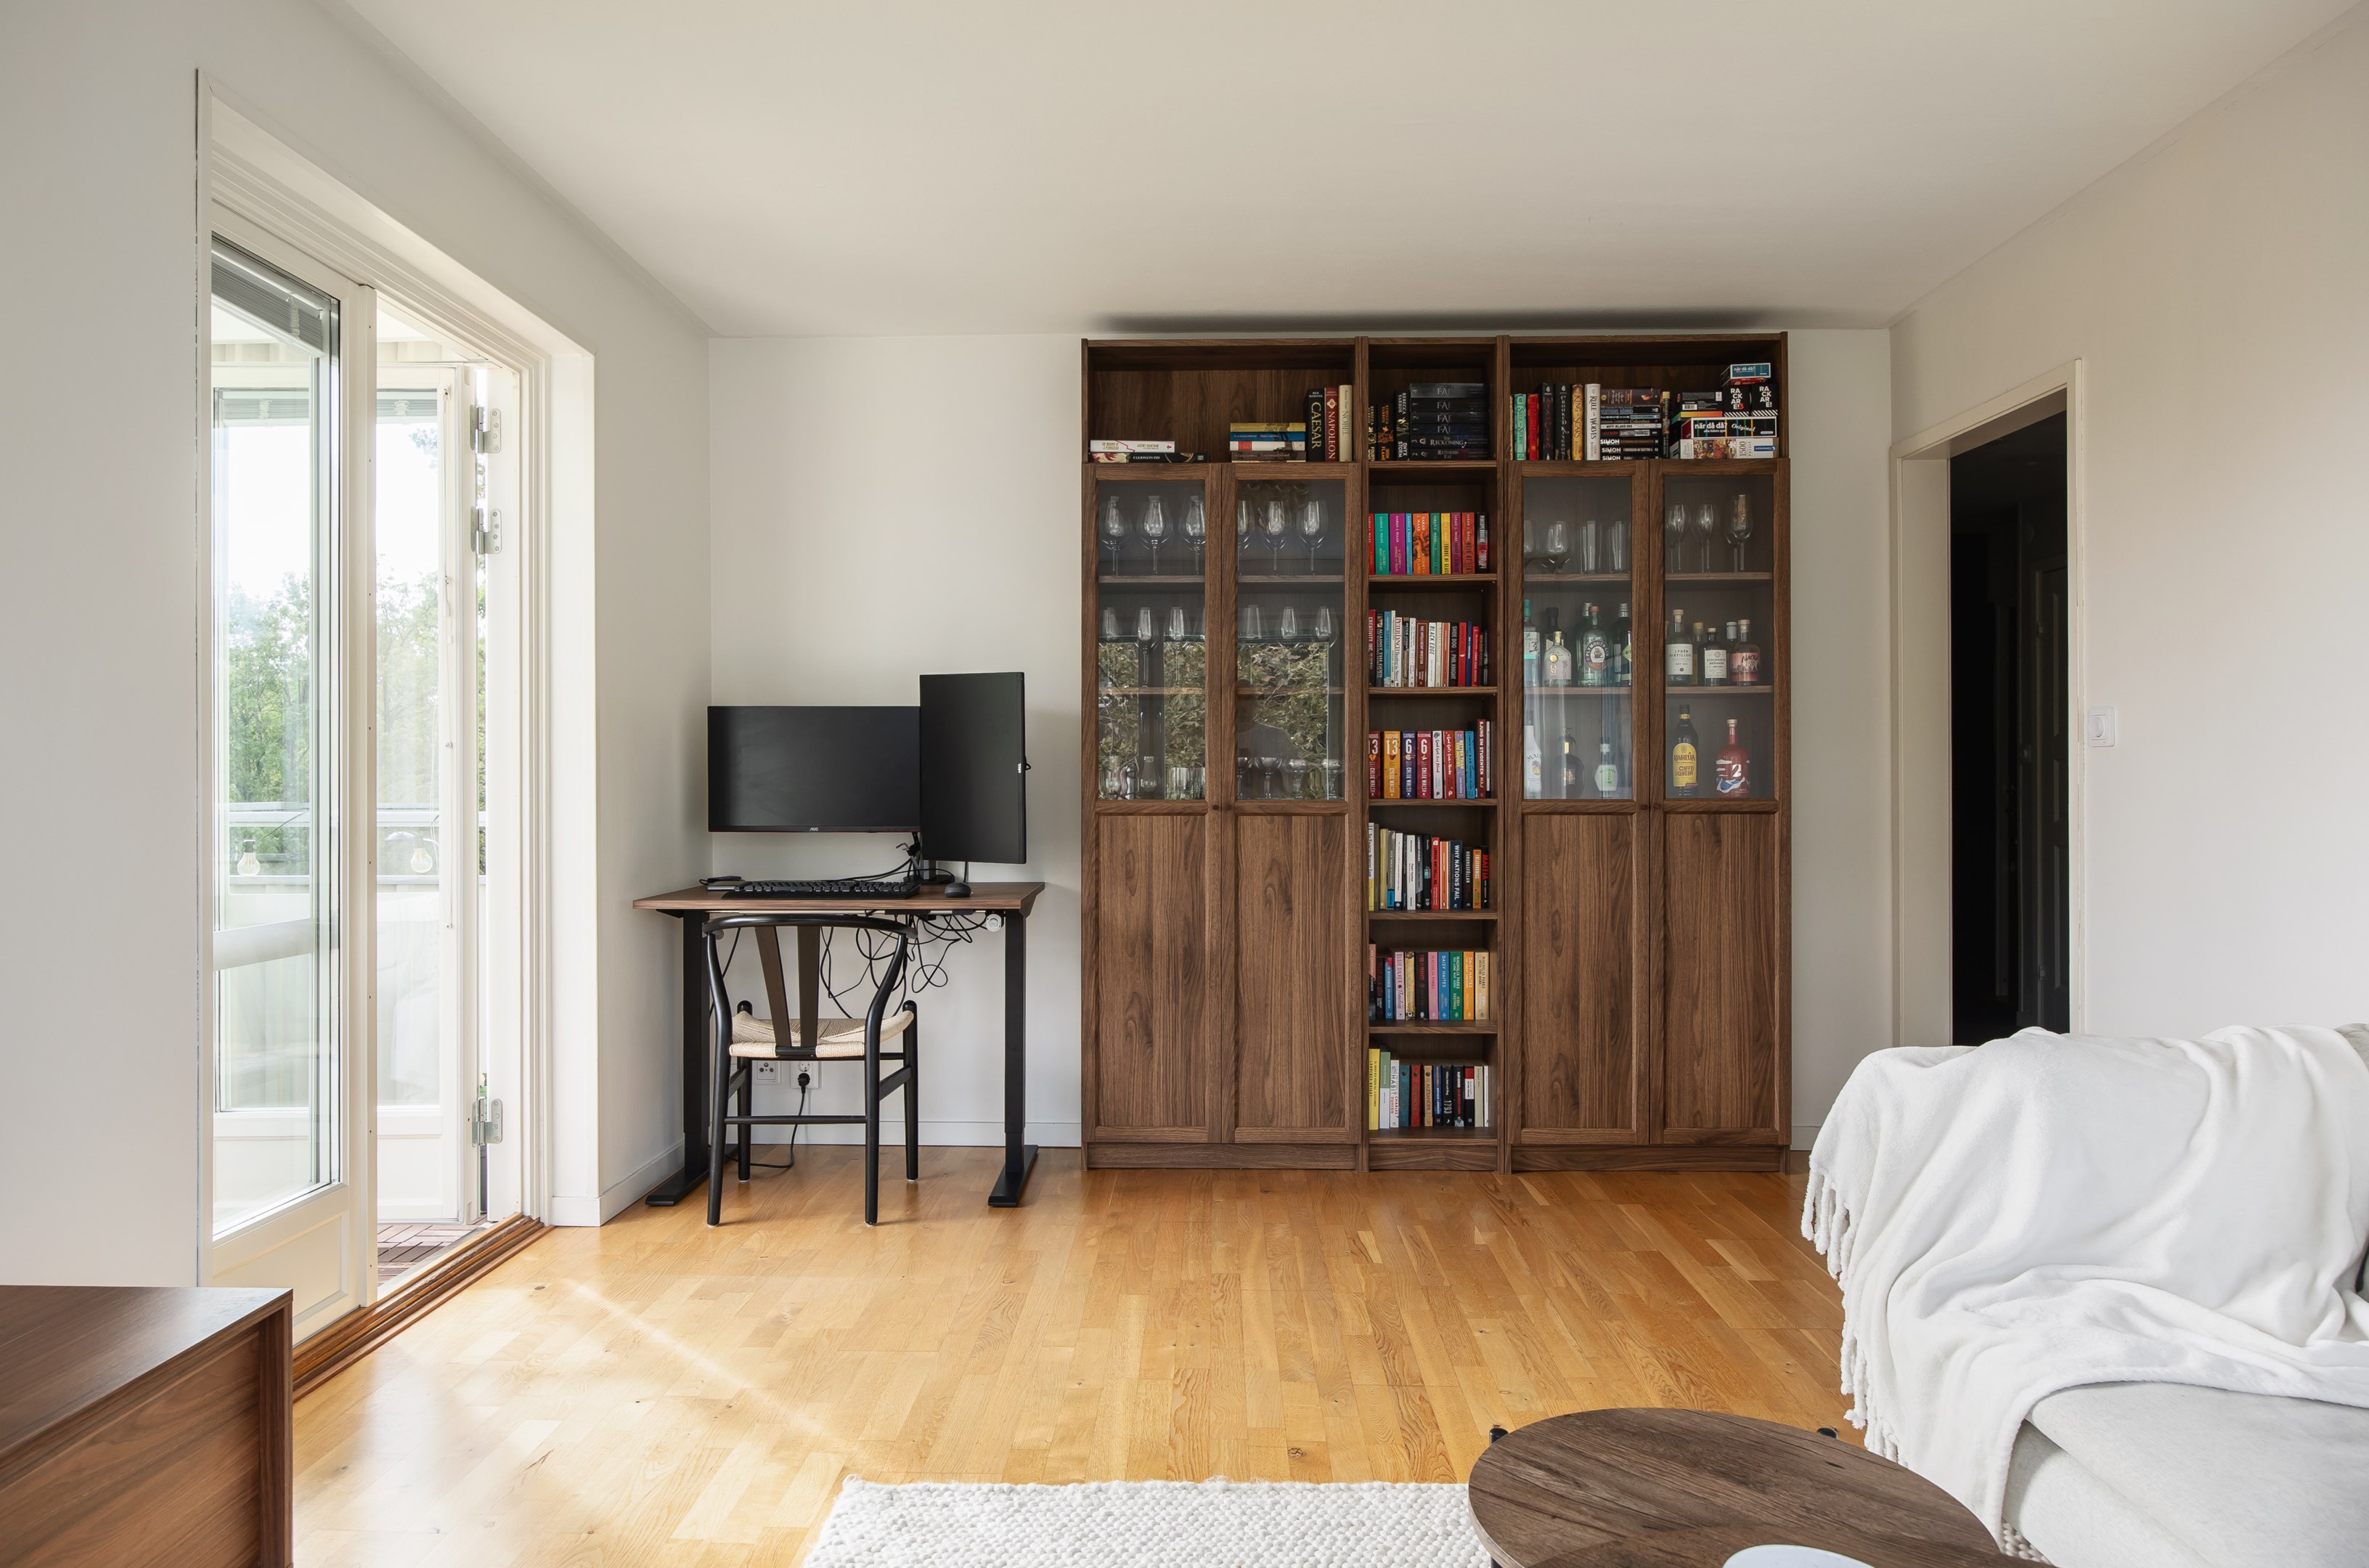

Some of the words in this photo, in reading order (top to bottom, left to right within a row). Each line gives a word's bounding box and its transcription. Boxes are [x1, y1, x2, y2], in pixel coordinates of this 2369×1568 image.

[1311, 402, 1321, 449] CAESAR
[1589, 418, 1598, 439] WOLVES
[1586, 642, 1606, 656] PLYMOUTH
[1386, 739, 1398, 755] 13
[1406, 739, 1412, 754] 6
[1421, 739, 1427, 754] 6
[1674, 752, 1695, 761] KAHLÚA
